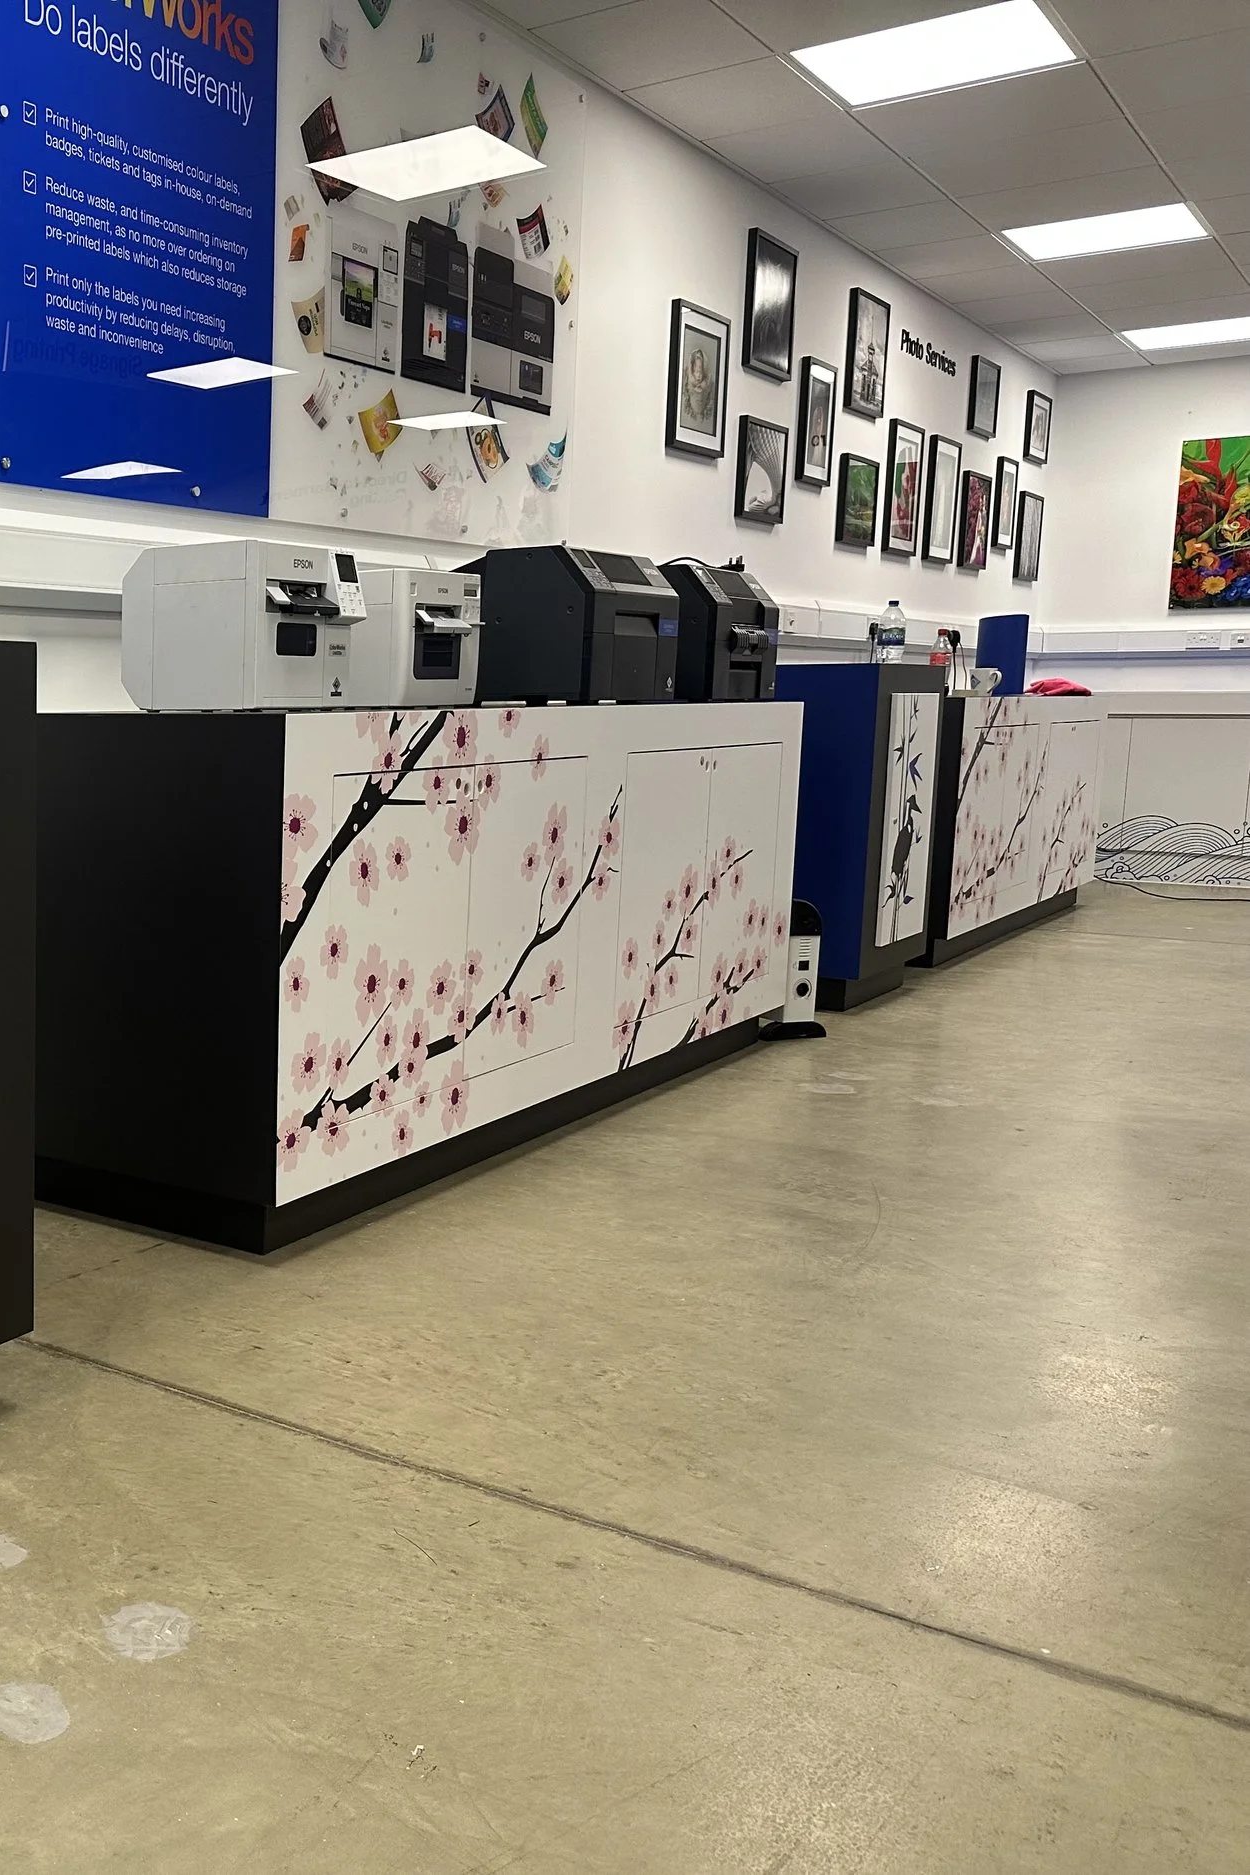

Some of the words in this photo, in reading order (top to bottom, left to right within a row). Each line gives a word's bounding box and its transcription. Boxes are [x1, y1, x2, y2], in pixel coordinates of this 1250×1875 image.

[24, 0, 61, 35] Do
[72, 4, 142, 71] labels
[150, 46, 253, 126] differently
[45, 107, 70, 130] Print
[71, 116, 130, 155] high-quality,
[132, 143, 184, 174] customised
[185, 164, 213, 185] colour
[214, 172, 240, 196] labels,
[45, 131, 86, 161] badges,
[88, 147, 120, 172] tickets
[122, 161, 140, 178] and
[142, 170, 162, 188] tags
[164, 174, 203, 203] in-house,
[205, 193, 253, 219] on-demand
[45, 176, 85, 202] Reduce
[86, 192, 118, 216] waste,
[120, 204, 138, 220] and
[140, 208, 210, 248] time-consuming
[211, 232, 249, 260] inventory
[45, 201, 113, 236] management,
[114, 224, 127, 237] as
[128, 228, 141, 242] no
[142, 233, 166, 250] more
[167, 241, 187, 257] over
[188, 245, 223, 272] ordering
[224, 259, 235, 273] on
[351, 242, 368, 255] EPSON
[45, 224, 101, 252] pre-printed
[102, 239, 131, 261] labels
[132, 250, 159, 270] which
[161, 258, 180, 276] also
[181, 266, 215, 287] reduces
[216, 278, 247, 298] storage
[45, 266, 70, 288] Print
[71, 275, 92, 296] only
[94, 281, 110, 298] the
[112, 286, 140, 306] labels
[141, 296, 158, 312] you
[159, 301, 182, 318] need
[183, 307, 226, 333] increasing
[45, 292, 103, 321] productivity
[105, 305, 118, 325] by
[119, 312, 159, 336] reducing
[160, 320, 191, 343] delays,
[193, 331, 236, 354] disruption,
[45, 315, 76, 333] waste
[78, 321, 97, 338] and
[98, 326, 164, 355] inconvenience
[523, 330, 542, 345] EPSON
[901, 328, 924, 360] Photo
[925, 342, 957, 377] Services
[293, 558, 314, 570] EPSON
